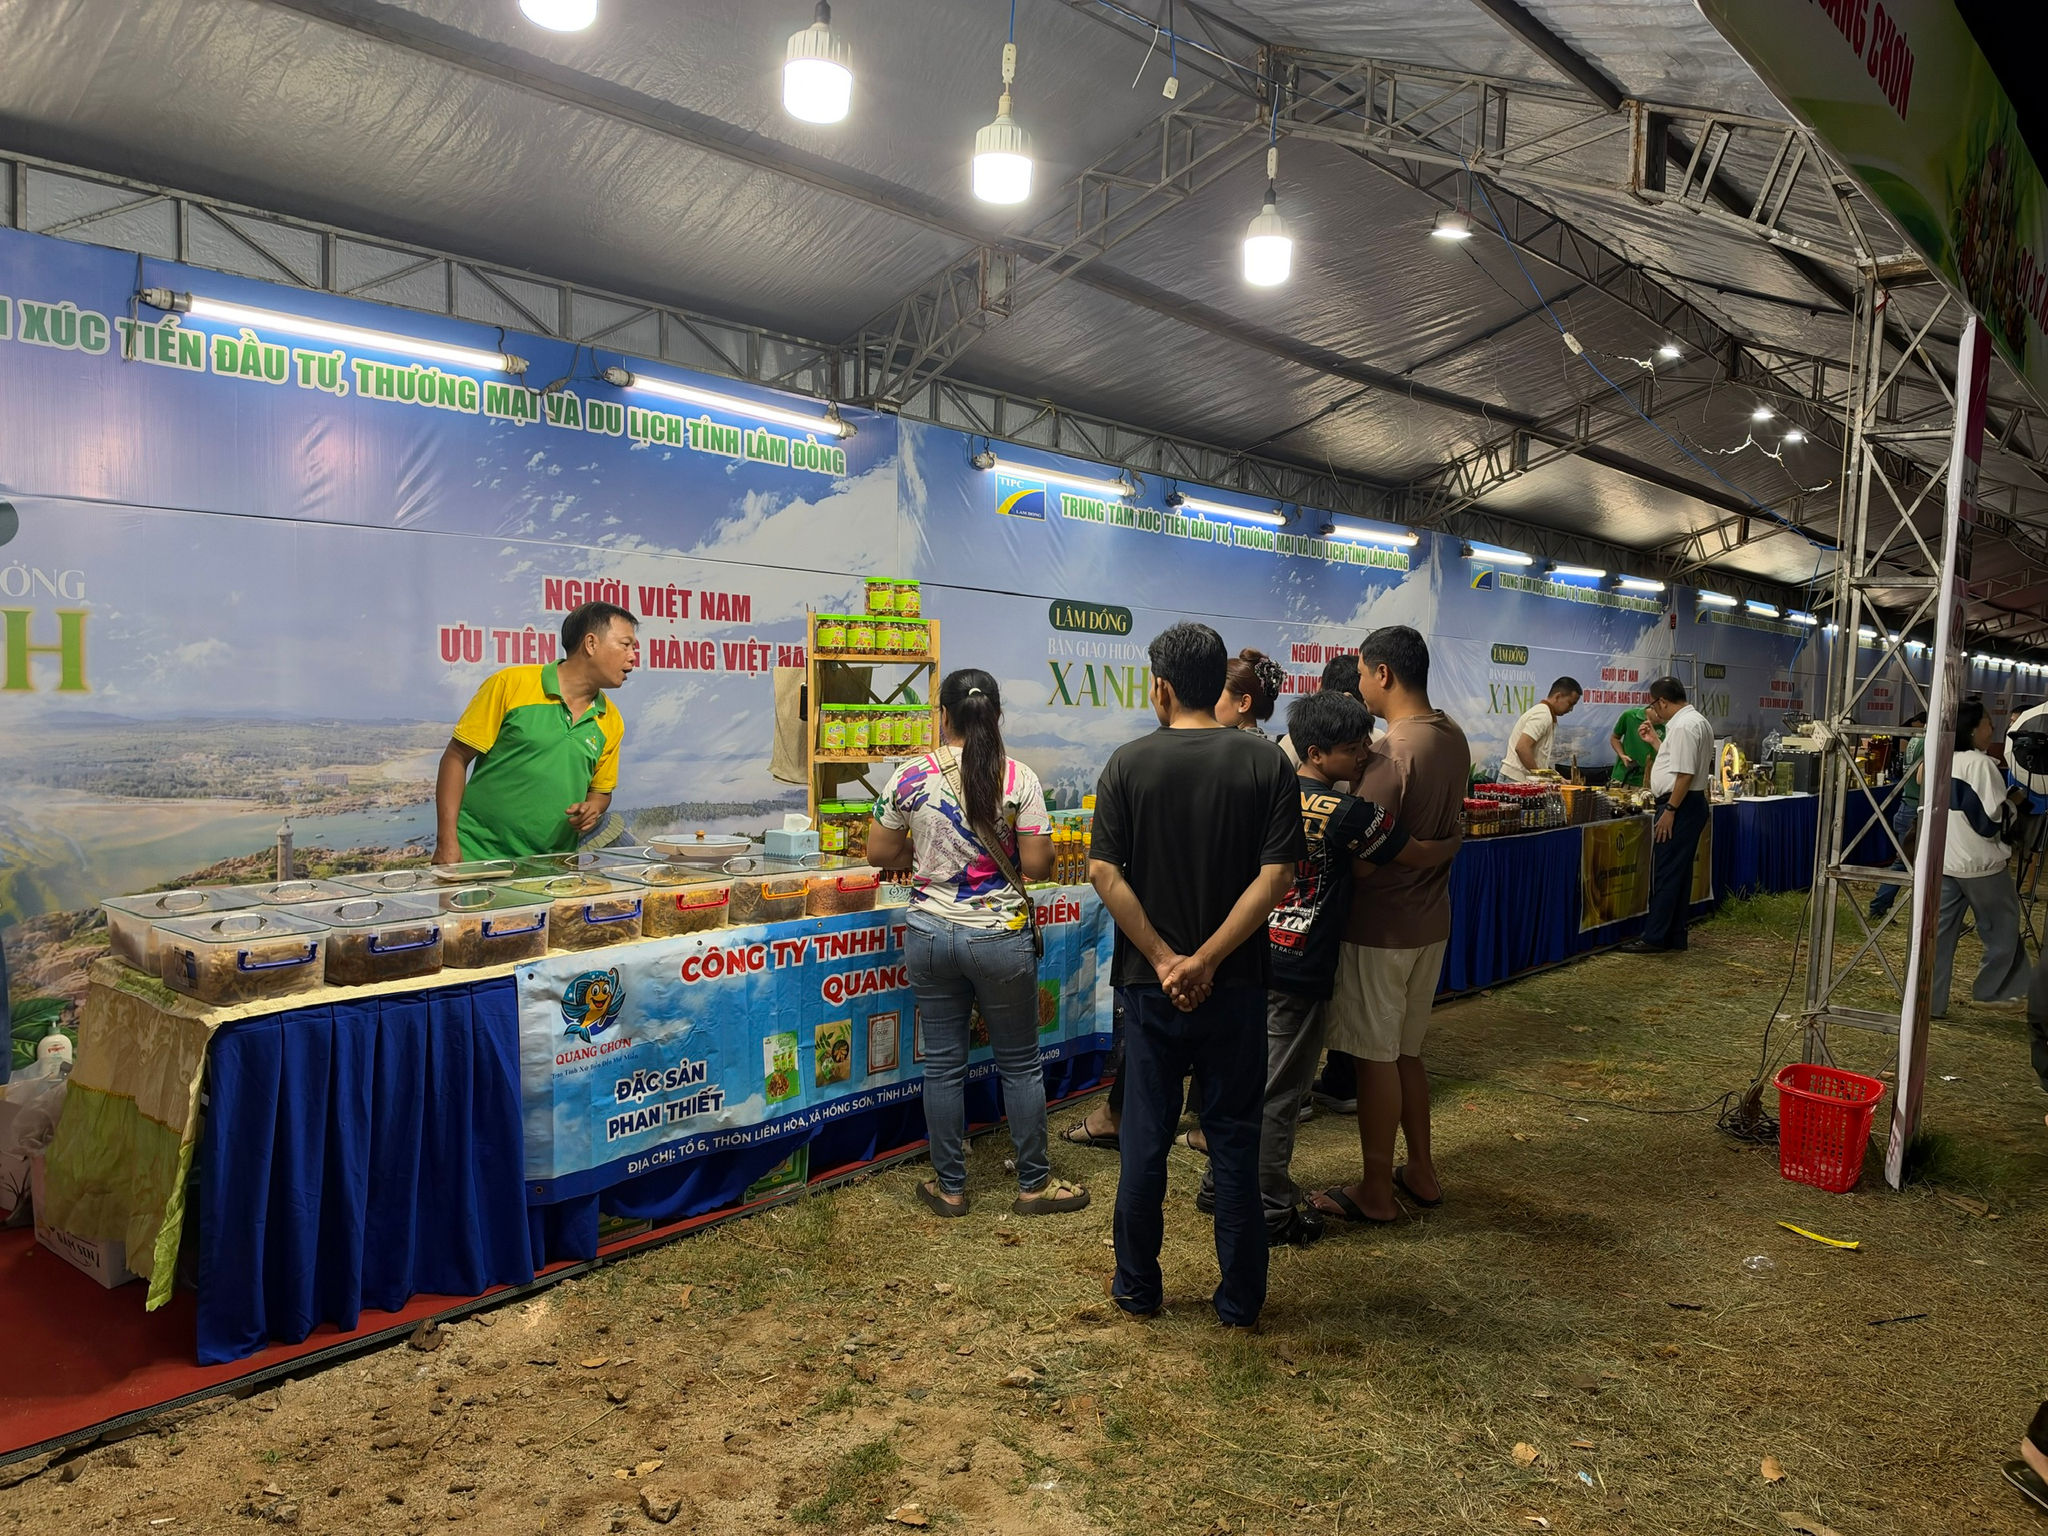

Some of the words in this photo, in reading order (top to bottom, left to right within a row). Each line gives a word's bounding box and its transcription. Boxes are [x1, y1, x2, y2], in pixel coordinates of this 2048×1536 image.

[22, 303, 106, 352] XÚC
[119, 316, 201, 366] TIẾN
[214, 329, 286, 382] ĐẦU
[297, 353, 347, 396] TƯ,
[355, 361, 478, 411] THƯƠNG
[486, 384, 538, 424] MẠI
[545, 388, 581, 428] VÀ
[589, 402, 622, 435] DU
[629, 408, 681, 446] LỊCH
[688, 413, 739, 455] TỈNH
[745, 428, 787, 464] LÂM
[793, 433, 845, 475] ĐỒNG
[1061, 494, 1105, 523] TRUNG
[1109, 501, 1134, 529] TÂM
[1137, 506, 1161, 532] XÚC
[1164, 509, 1188, 537] TIẾN
[1191, 513, 1212, 541] ĐẦU
[1233, 526, 1274, 551] THƯƠNG
[1310, 539, 1323, 559] DU
[544, 576, 631, 617] NGƯỜI
[639, 584, 693, 624] VIỆT
[700, 590, 751, 623] NAM
[1055, 605, 1086, 629] LÂM
[1089, 608, 1127, 632] ĐỒNG
[441, 622, 482, 663] ƯU
[492, 625, 557, 665] TIÊN
[649, 634, 715, 671] HÀNG
[722, 637, 771, 677] VIỆT
[777, 643, 806, 669] NA
[1291, 642, 1322, 663] NGƯỜI
[1047, 660, 1150, 709] XANH
[1297, 673, 1322, 694] DÙN
[1487, 683, 1535, 714] XANH
[1035, 895, 1080, 926] BIỂN
[681, 945, 765, 983] CÔNG
[773, 939, 807, 967] TY
[813, 928, 886, 960] TNHH
[555, 1046, 598, 1066] QUANG
[616, 1069, 660, 1102] ĐẶC
[665, 1060, 705, 1085] SẢN
[609, 1106, 661, 1140] PHAN
[668, 1086, 724, 1122] THIẾT
[627, 1160, 650, 1174] ĐỊA
[651, 1149, 677, 1165] CHỊ:
[678, 1140, 695, 1157] TỔ
[697, 1140, 710, 1153] 6,
[713, 1131, 752, 1148] THÔN
[754, 1124, 780, 1141] LIÊM
[783, 1114, 809, 1132] HÒA,
[809, 1109, 821, 1124] XÃ
[822, 1102, 851, 1120] HỒNG
[852, 1096, 875, 1111] SƠN,
[876, 1089, 901, 1105] TỈNH
[901, 1082, 922, 1097] LÂM
